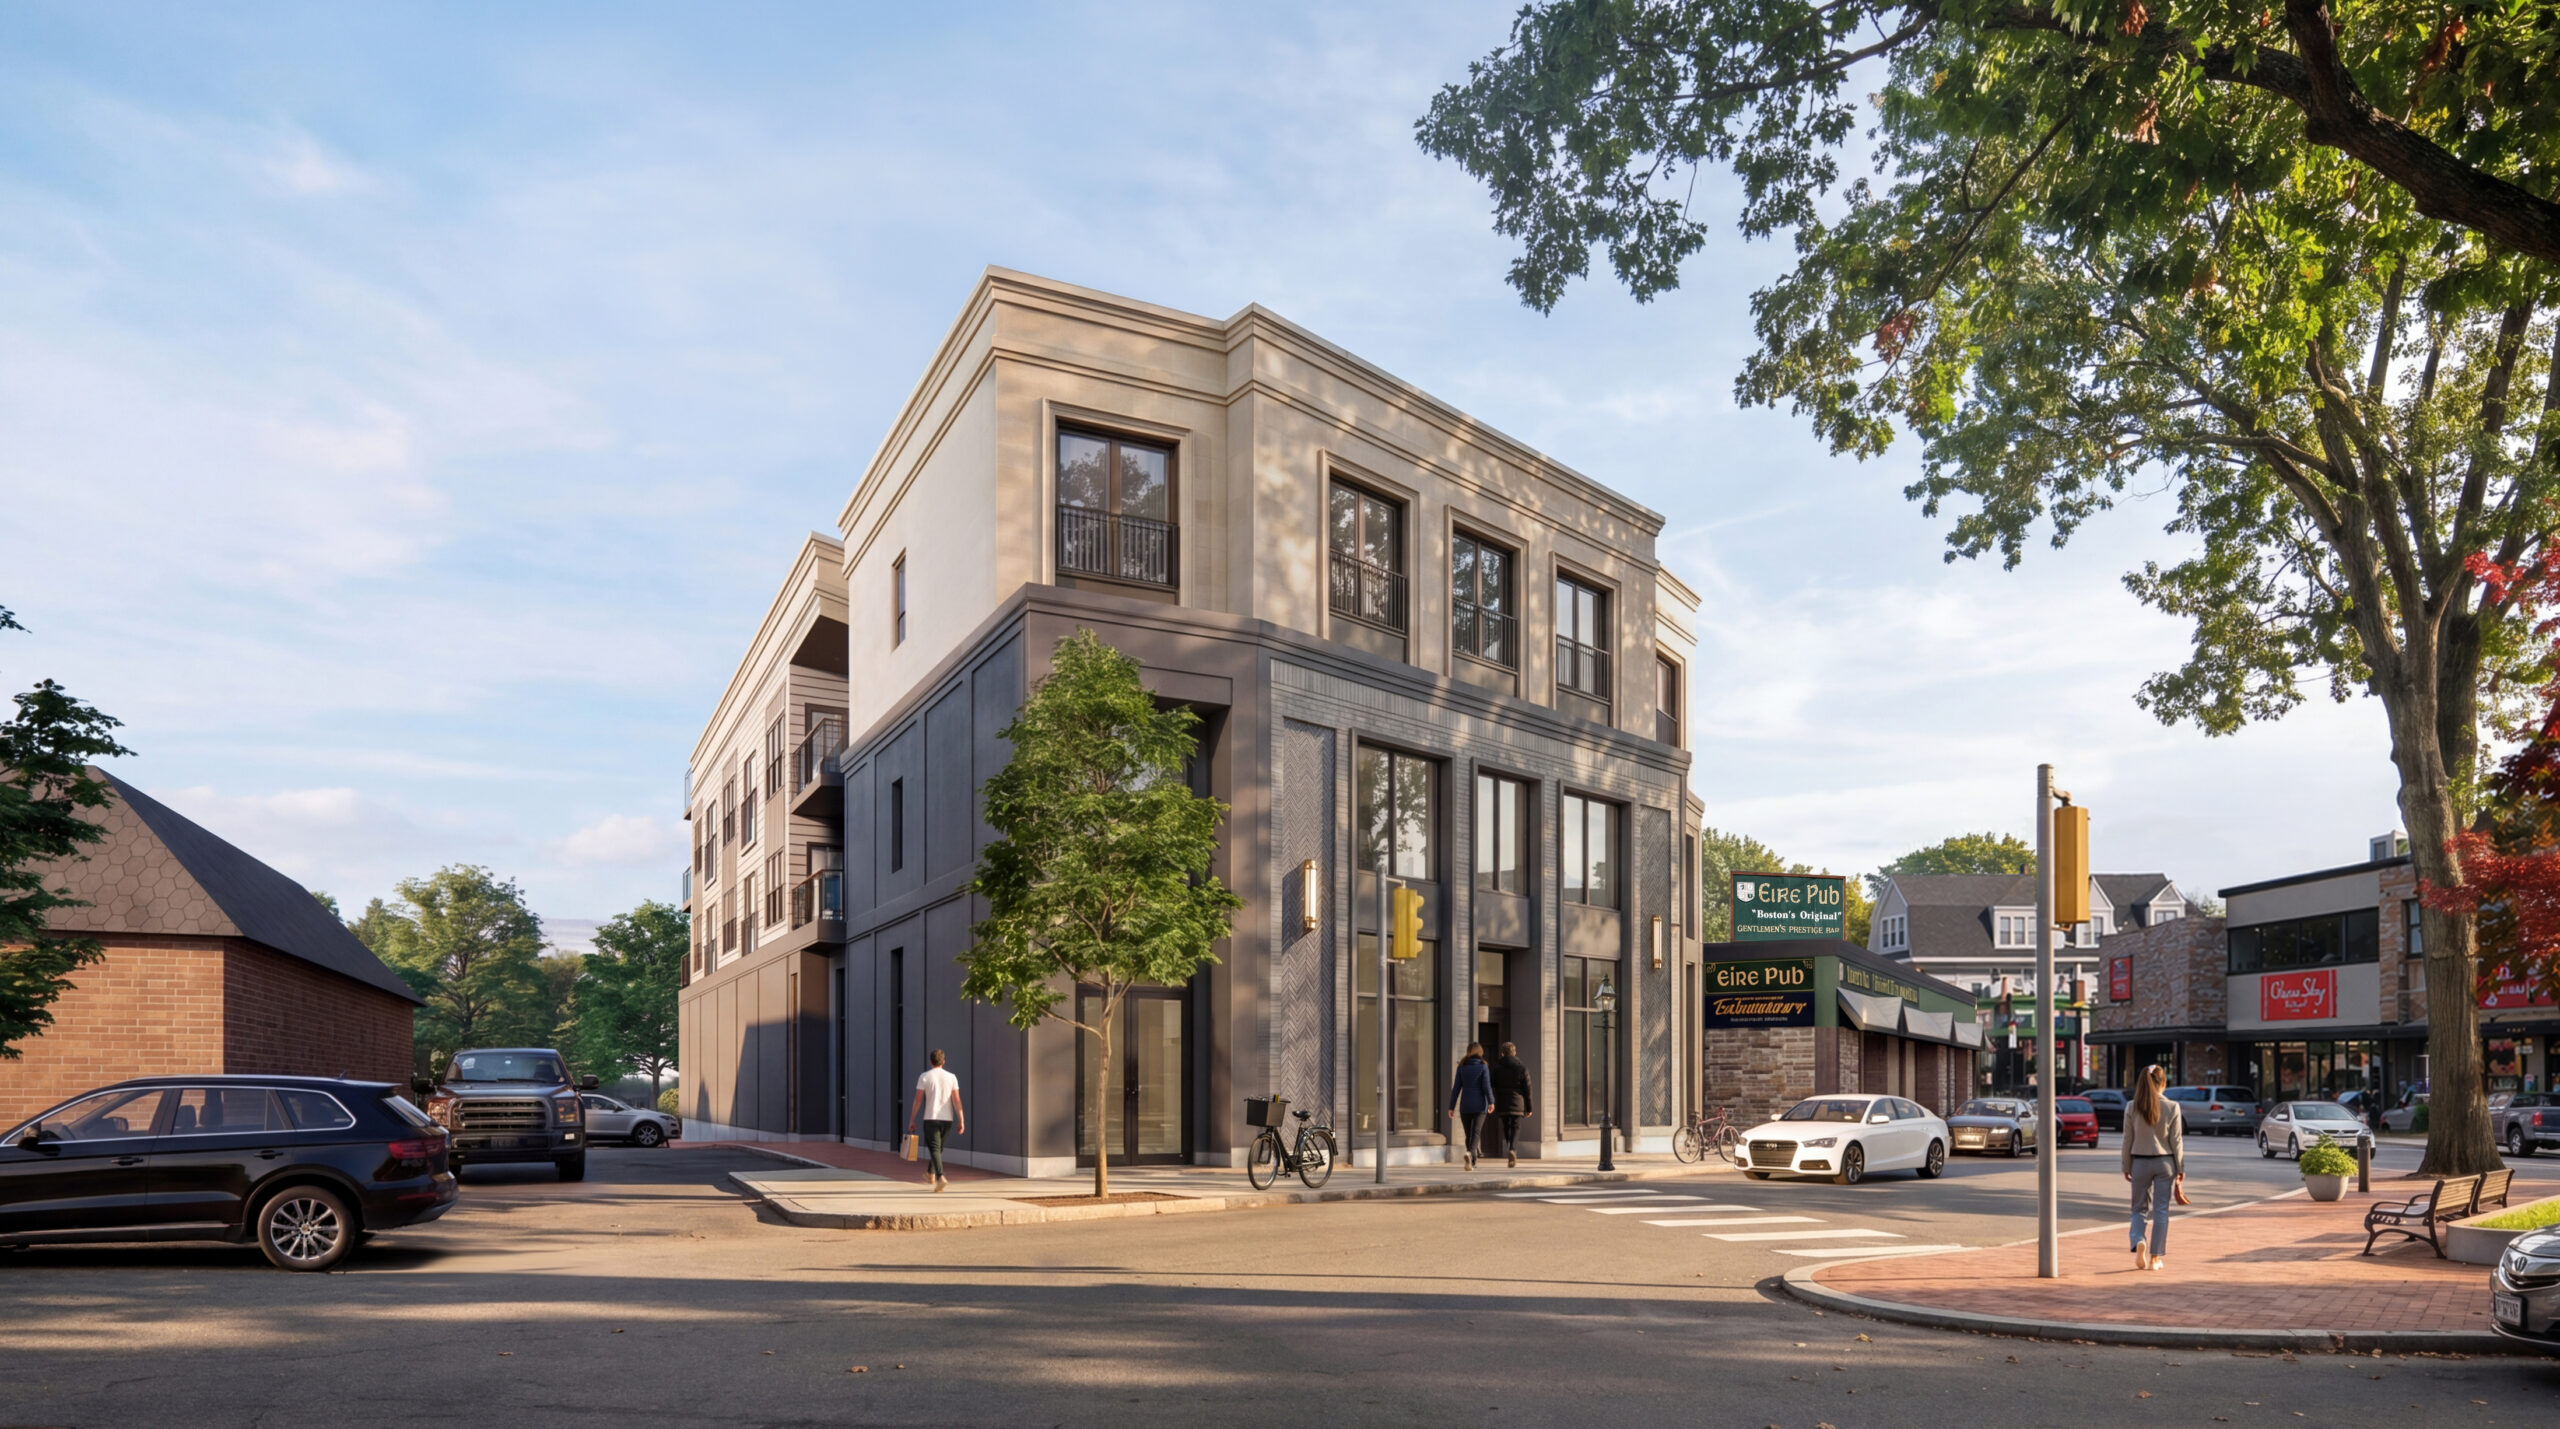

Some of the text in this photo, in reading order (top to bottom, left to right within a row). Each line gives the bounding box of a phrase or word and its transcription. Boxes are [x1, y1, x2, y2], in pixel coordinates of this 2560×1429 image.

[1806, 883, 1840, 905] Pub
[1737, 924, 1786, 933] GENTLEMEN'S
[1788, 925, 1824, 934] PRESTIGE
[1764, 966, 1805, 985] Pub
